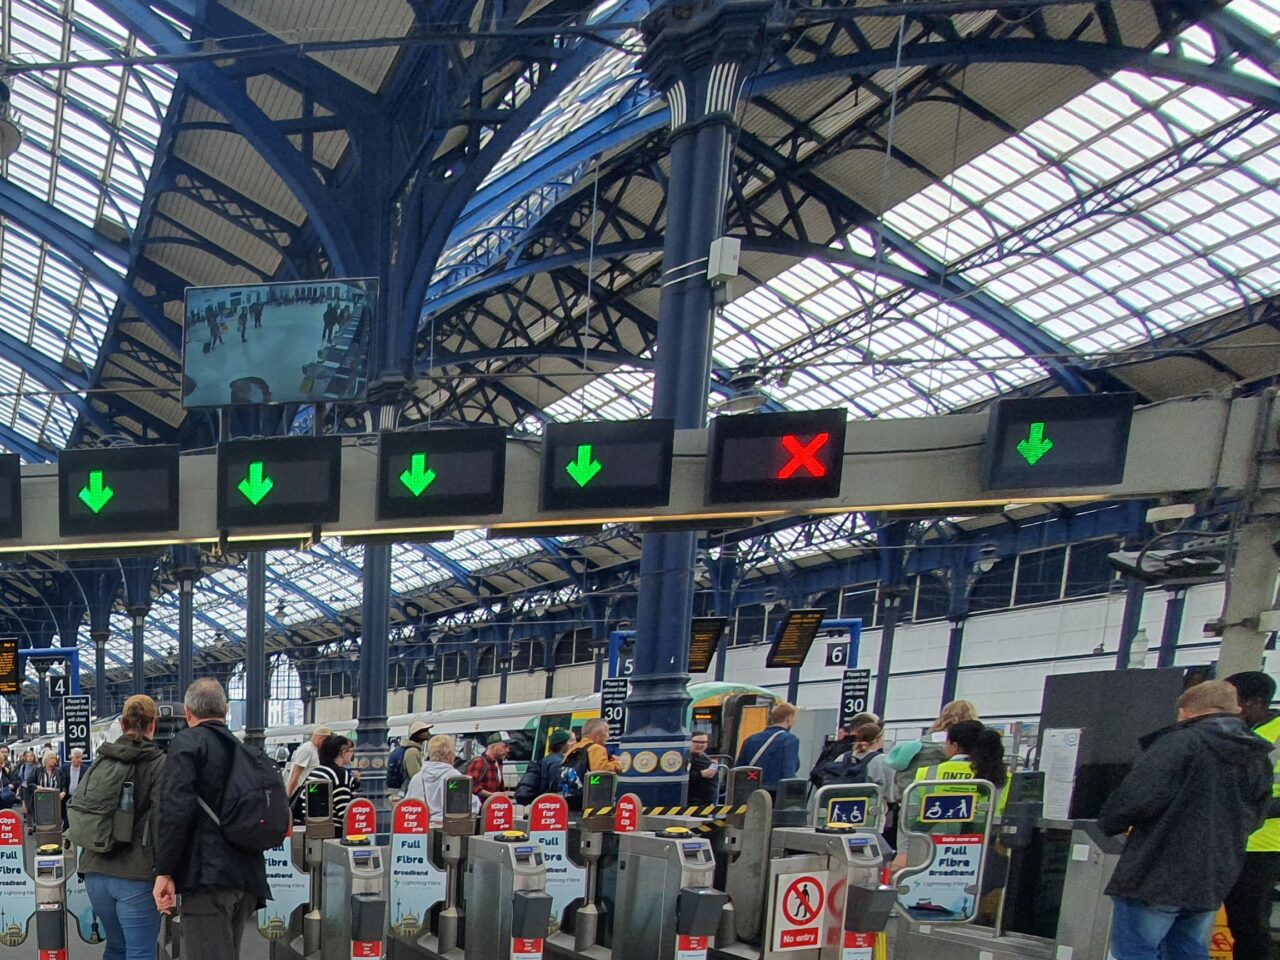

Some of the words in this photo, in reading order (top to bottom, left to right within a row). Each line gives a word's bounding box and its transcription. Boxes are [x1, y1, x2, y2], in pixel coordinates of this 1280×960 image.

[832, 647, 842, 662] 6
[624, 659, 633, 674] 5
[55, 679, 65, 694] 4
[844, 698, 864, 712] 30
[604, 707, 622, 720] 30
[69, 725, 87, 738] 30
[544, 853, 562, 861] bre
[944, 846, 967, 855] Full
[397, 856, 423, 864] Fibre
[939, 858, 970, 867] Fibre
[783, 934, 794, 943] No
[796, 932, 816, 944] entry
